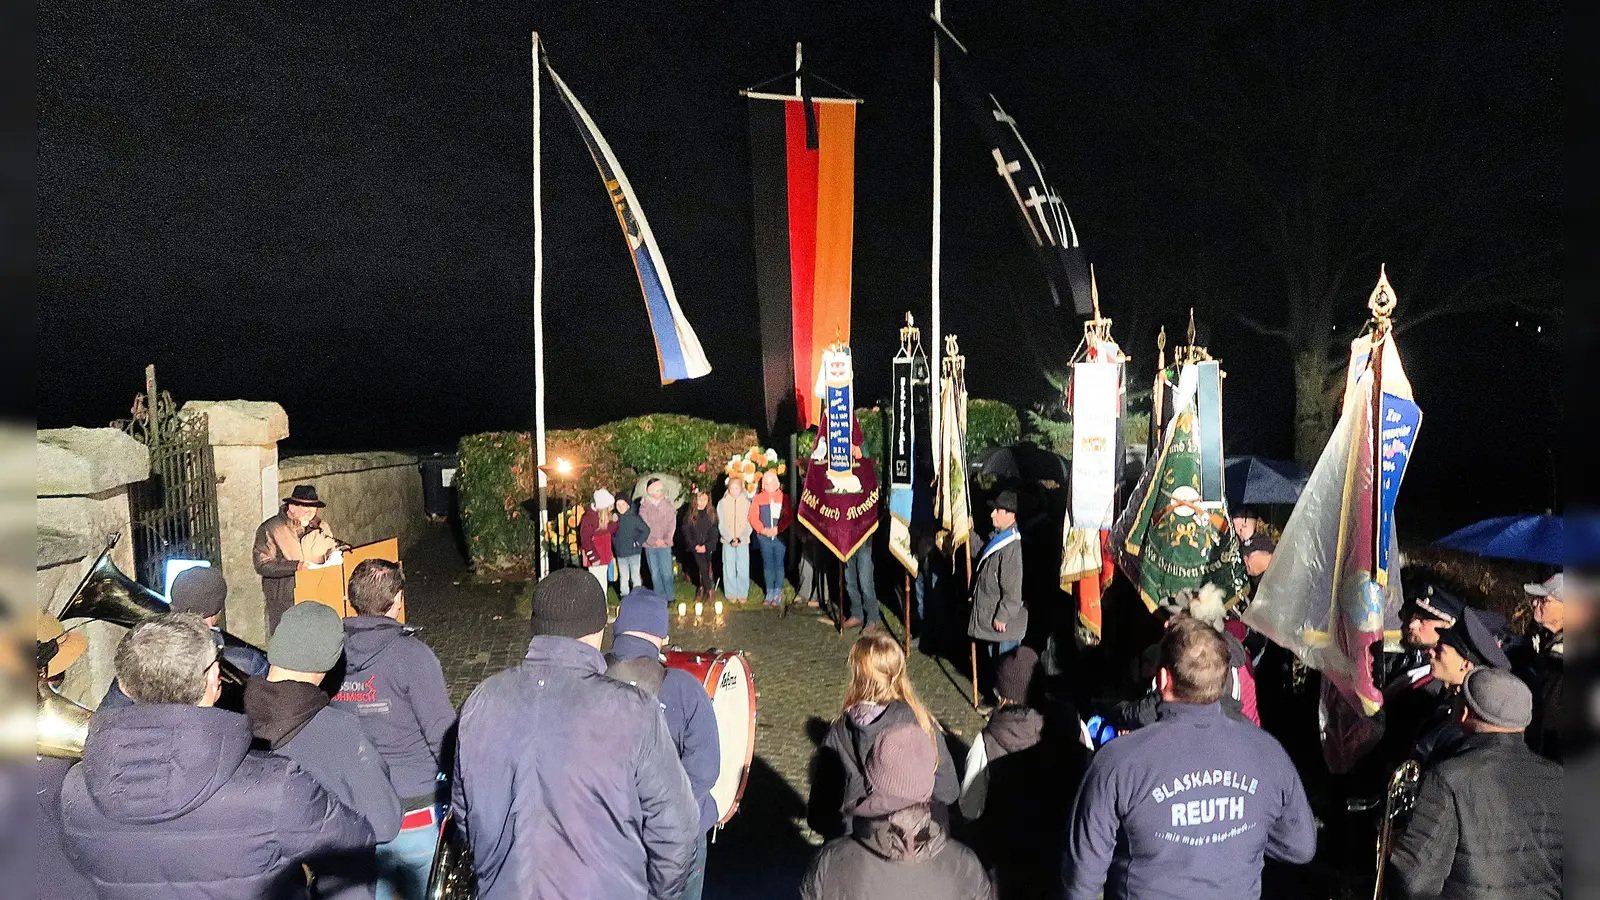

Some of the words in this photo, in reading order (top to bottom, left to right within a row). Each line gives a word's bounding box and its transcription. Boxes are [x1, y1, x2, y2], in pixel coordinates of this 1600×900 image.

[820, 504, 841, 522] auch
[1151, 769, 1259, 804] BLASKAPELLE
[1171, 795, 1245, 827] REUTH
